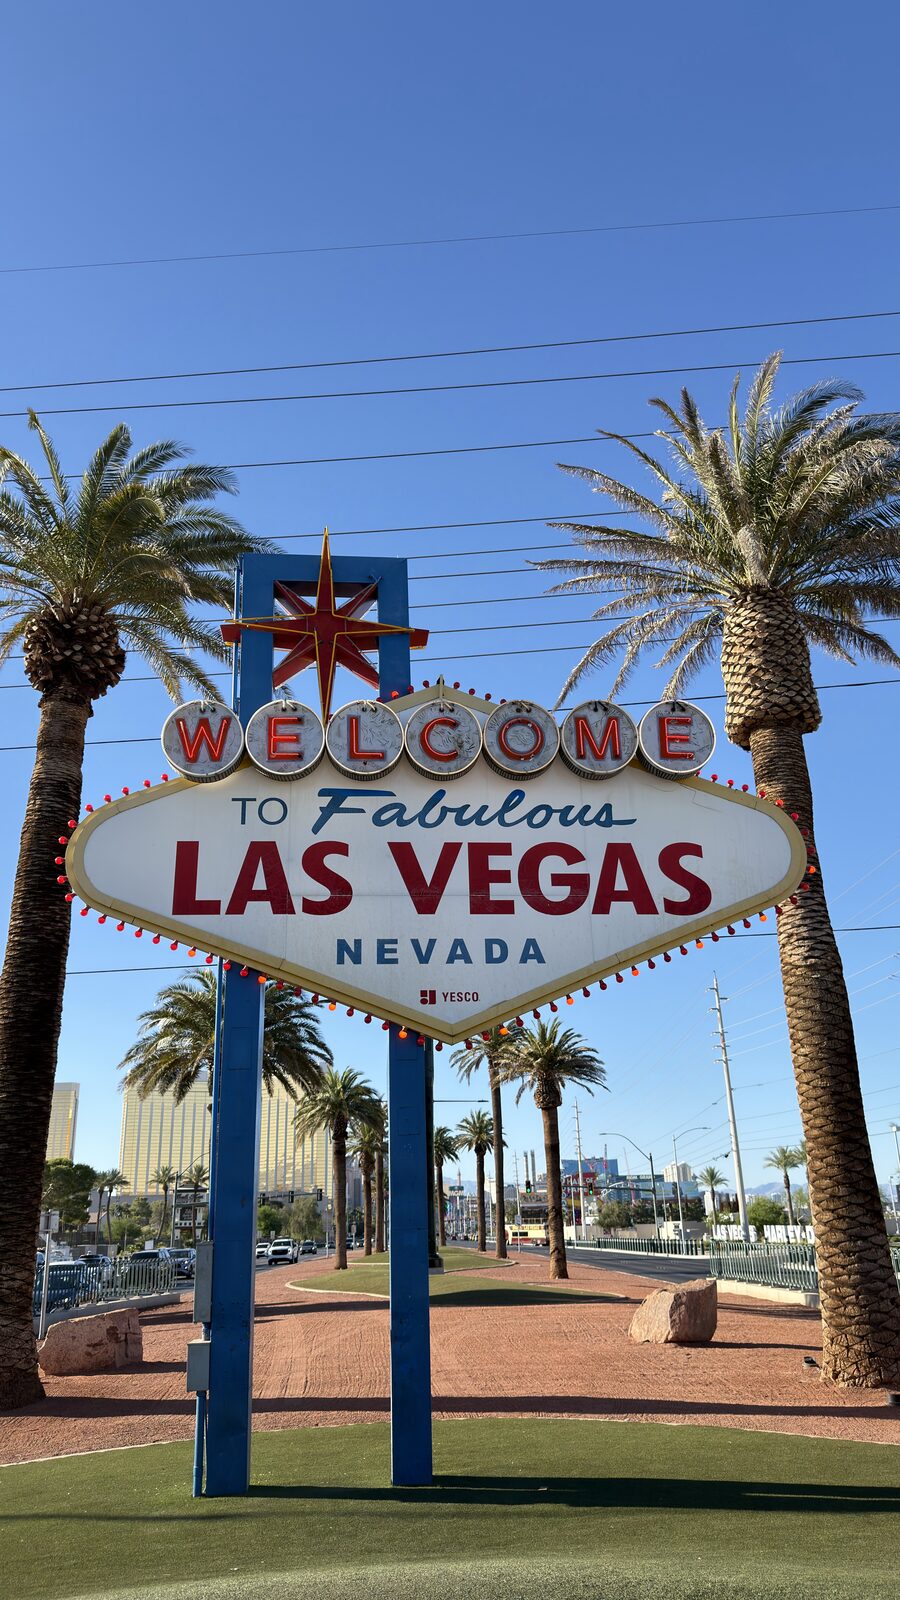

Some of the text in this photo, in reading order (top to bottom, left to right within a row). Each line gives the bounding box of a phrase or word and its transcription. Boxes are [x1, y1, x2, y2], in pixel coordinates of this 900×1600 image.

[175, 715, 696, 763] WELCOME
[231, 787, 637, 836] TO Fabulous
[172, 841, 712, 916] LAS VEGAS
[335, 937, 547, 966] NEVADA
[441, 991, 479, 1002] YESCO
[727, 1225, 758, 1243] VEGS
